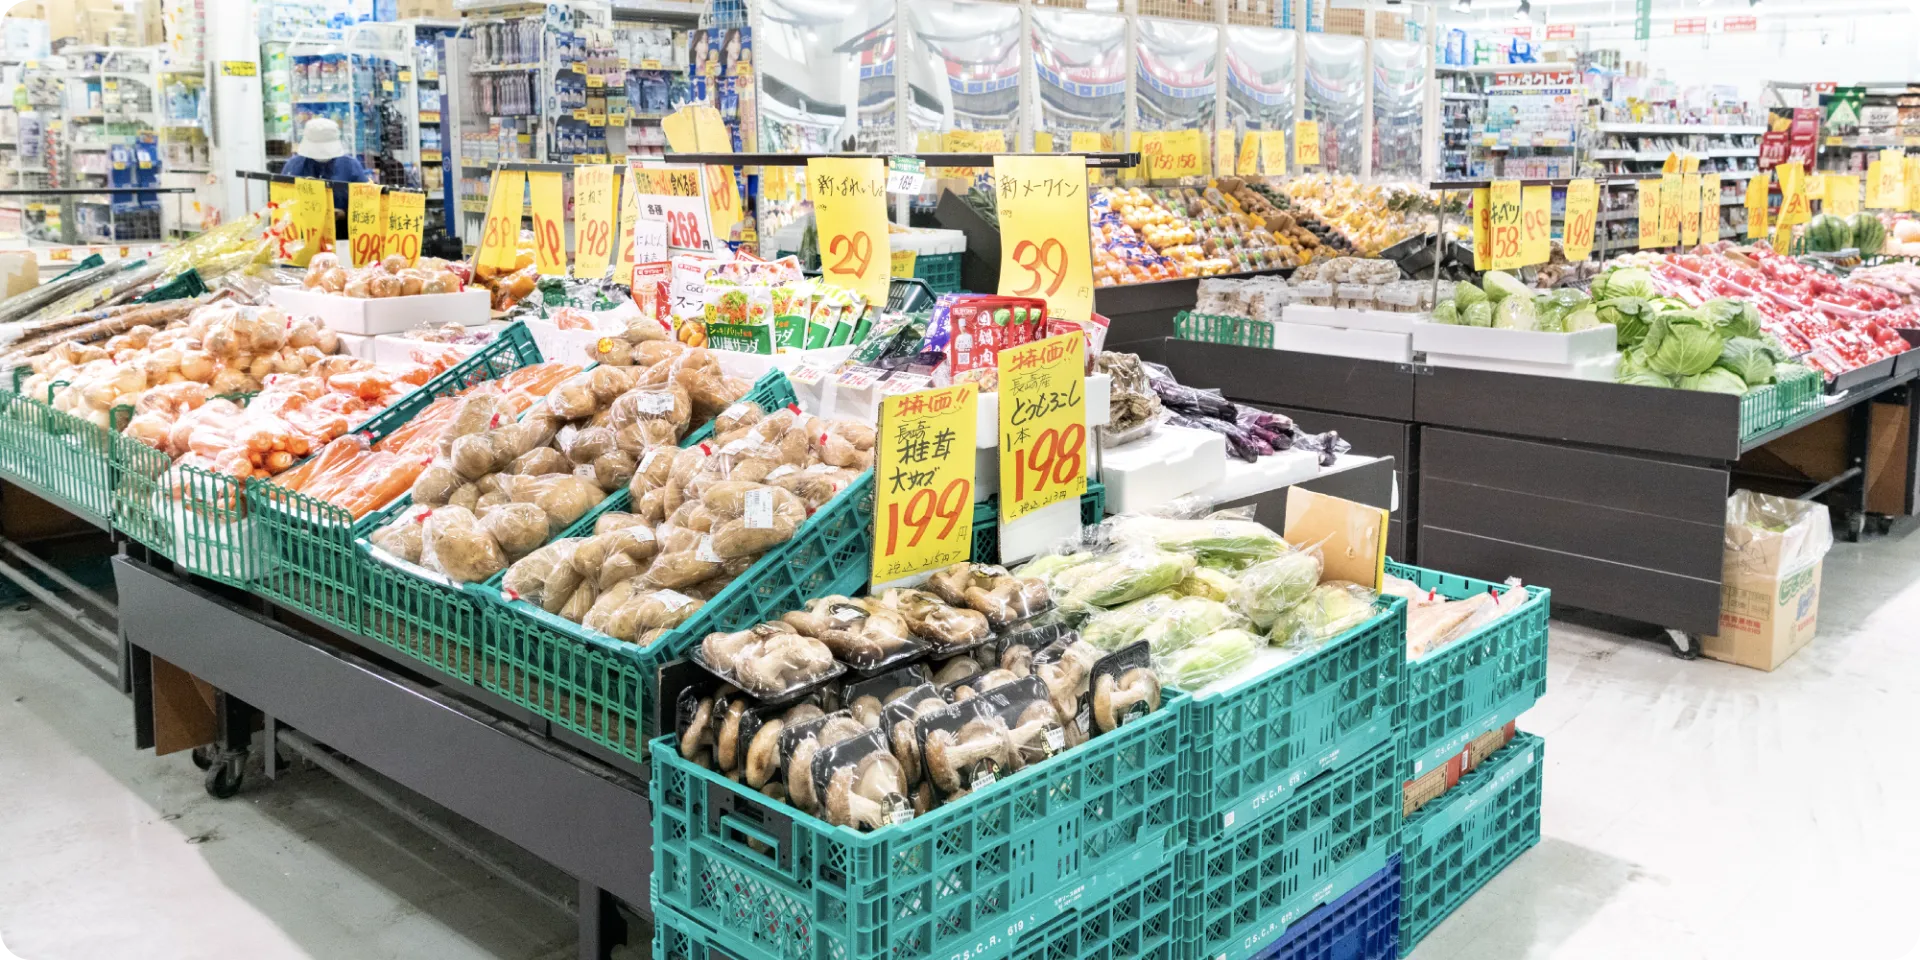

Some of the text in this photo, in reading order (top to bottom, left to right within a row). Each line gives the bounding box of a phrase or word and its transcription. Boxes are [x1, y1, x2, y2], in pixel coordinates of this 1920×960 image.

[667, 210, 711, 251] 268 円
[1490, 201, 1520, 225] キャベツ
[1566, 208, 1593, 247] 198
[578, 219, 610, 257] 198
[829, 231, 873, 280] 29
[1491, 226, 1519, 259] 158
[1012, 237, 1069, 298] 39
[977, 310, 996, 367] 回鍋肉
[1010, 380, 1081, 427] とうもろこし
[889, 466, 941, 495] 大サイズ
[1014, 423, 1086, 504] 198
[885, 477, 970, 557] 199
[1260, 784, 1286, 804] S.C.R.
[963, 934, 1002, 960] S.C.R.
[1007, 919, 1025, 937] 619
[1252, 921, 1279, 943] S.C.R.
